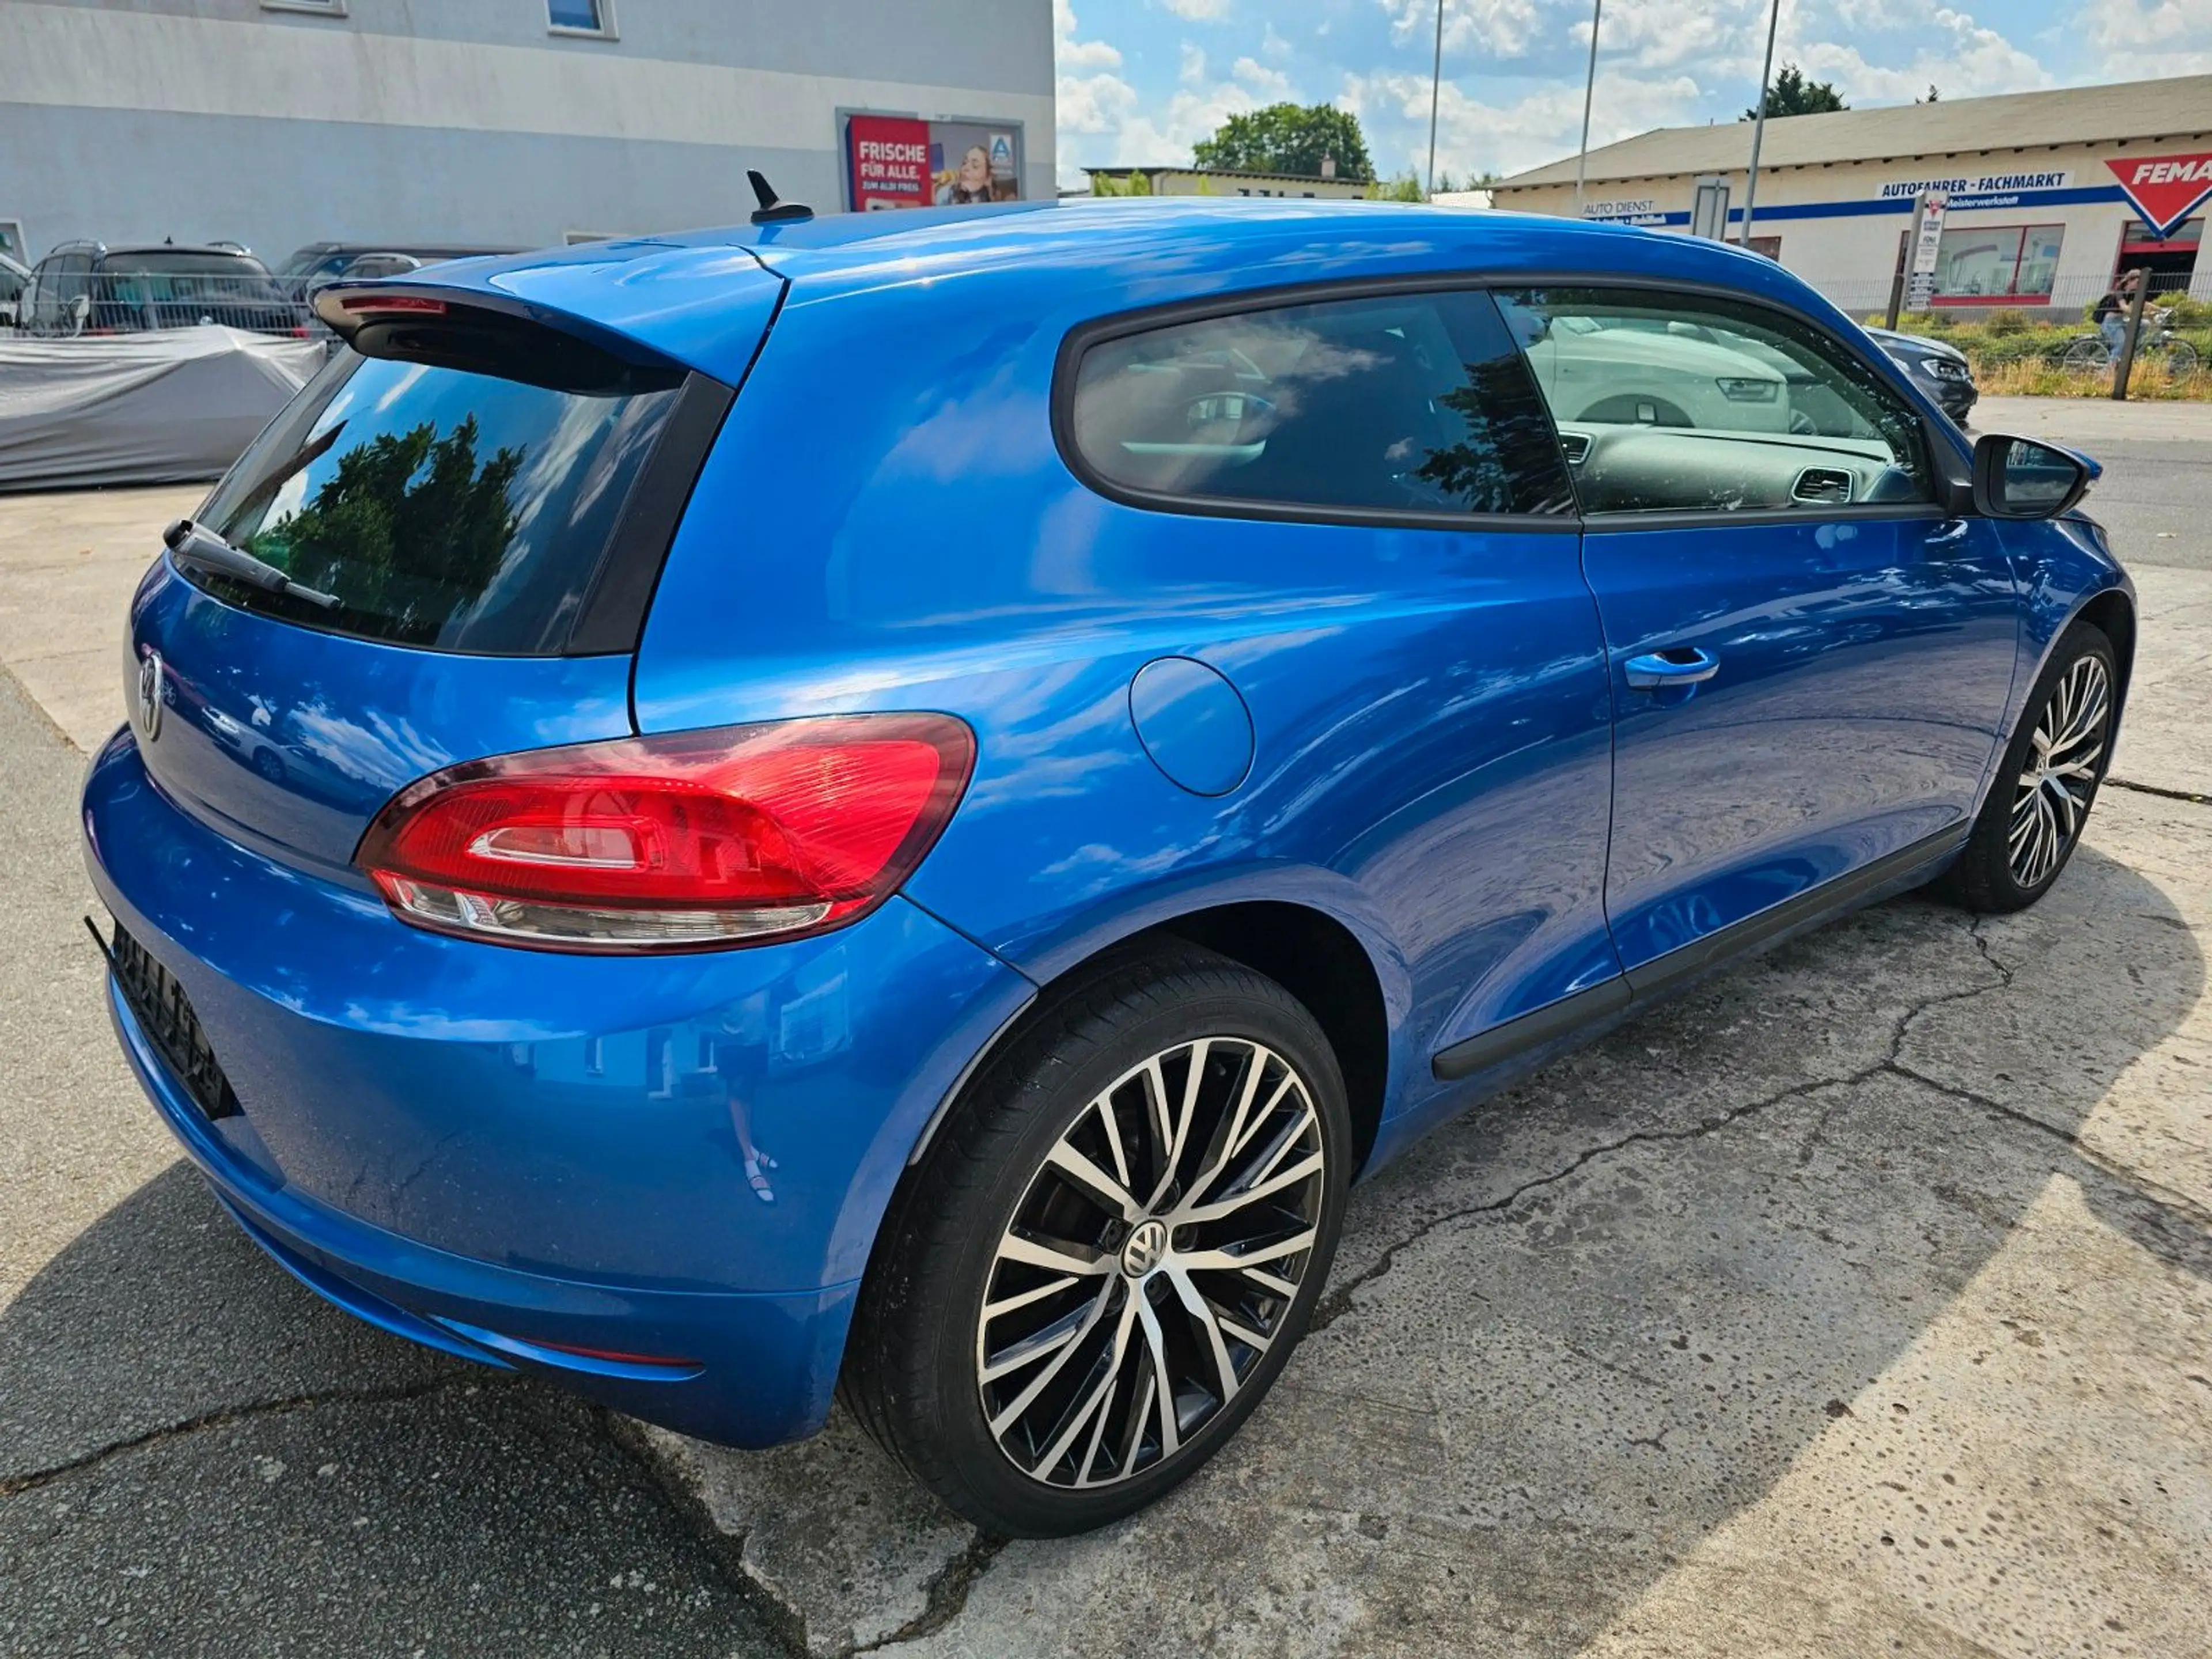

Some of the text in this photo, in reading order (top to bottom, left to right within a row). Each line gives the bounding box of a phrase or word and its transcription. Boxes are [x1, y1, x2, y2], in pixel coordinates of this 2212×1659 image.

[859, 141, 926, 164] FRISCHE
[861, 161, 921, 180] FÜR ALLE.
[2131, 160, 2212, 185] FEMA
[1882, 180, 1967, 197] AUTOFAHRER
[1978, 173, 2066, 191] FACHMARKT
[1583, 200, 1654, 214] AUTO DIENST
